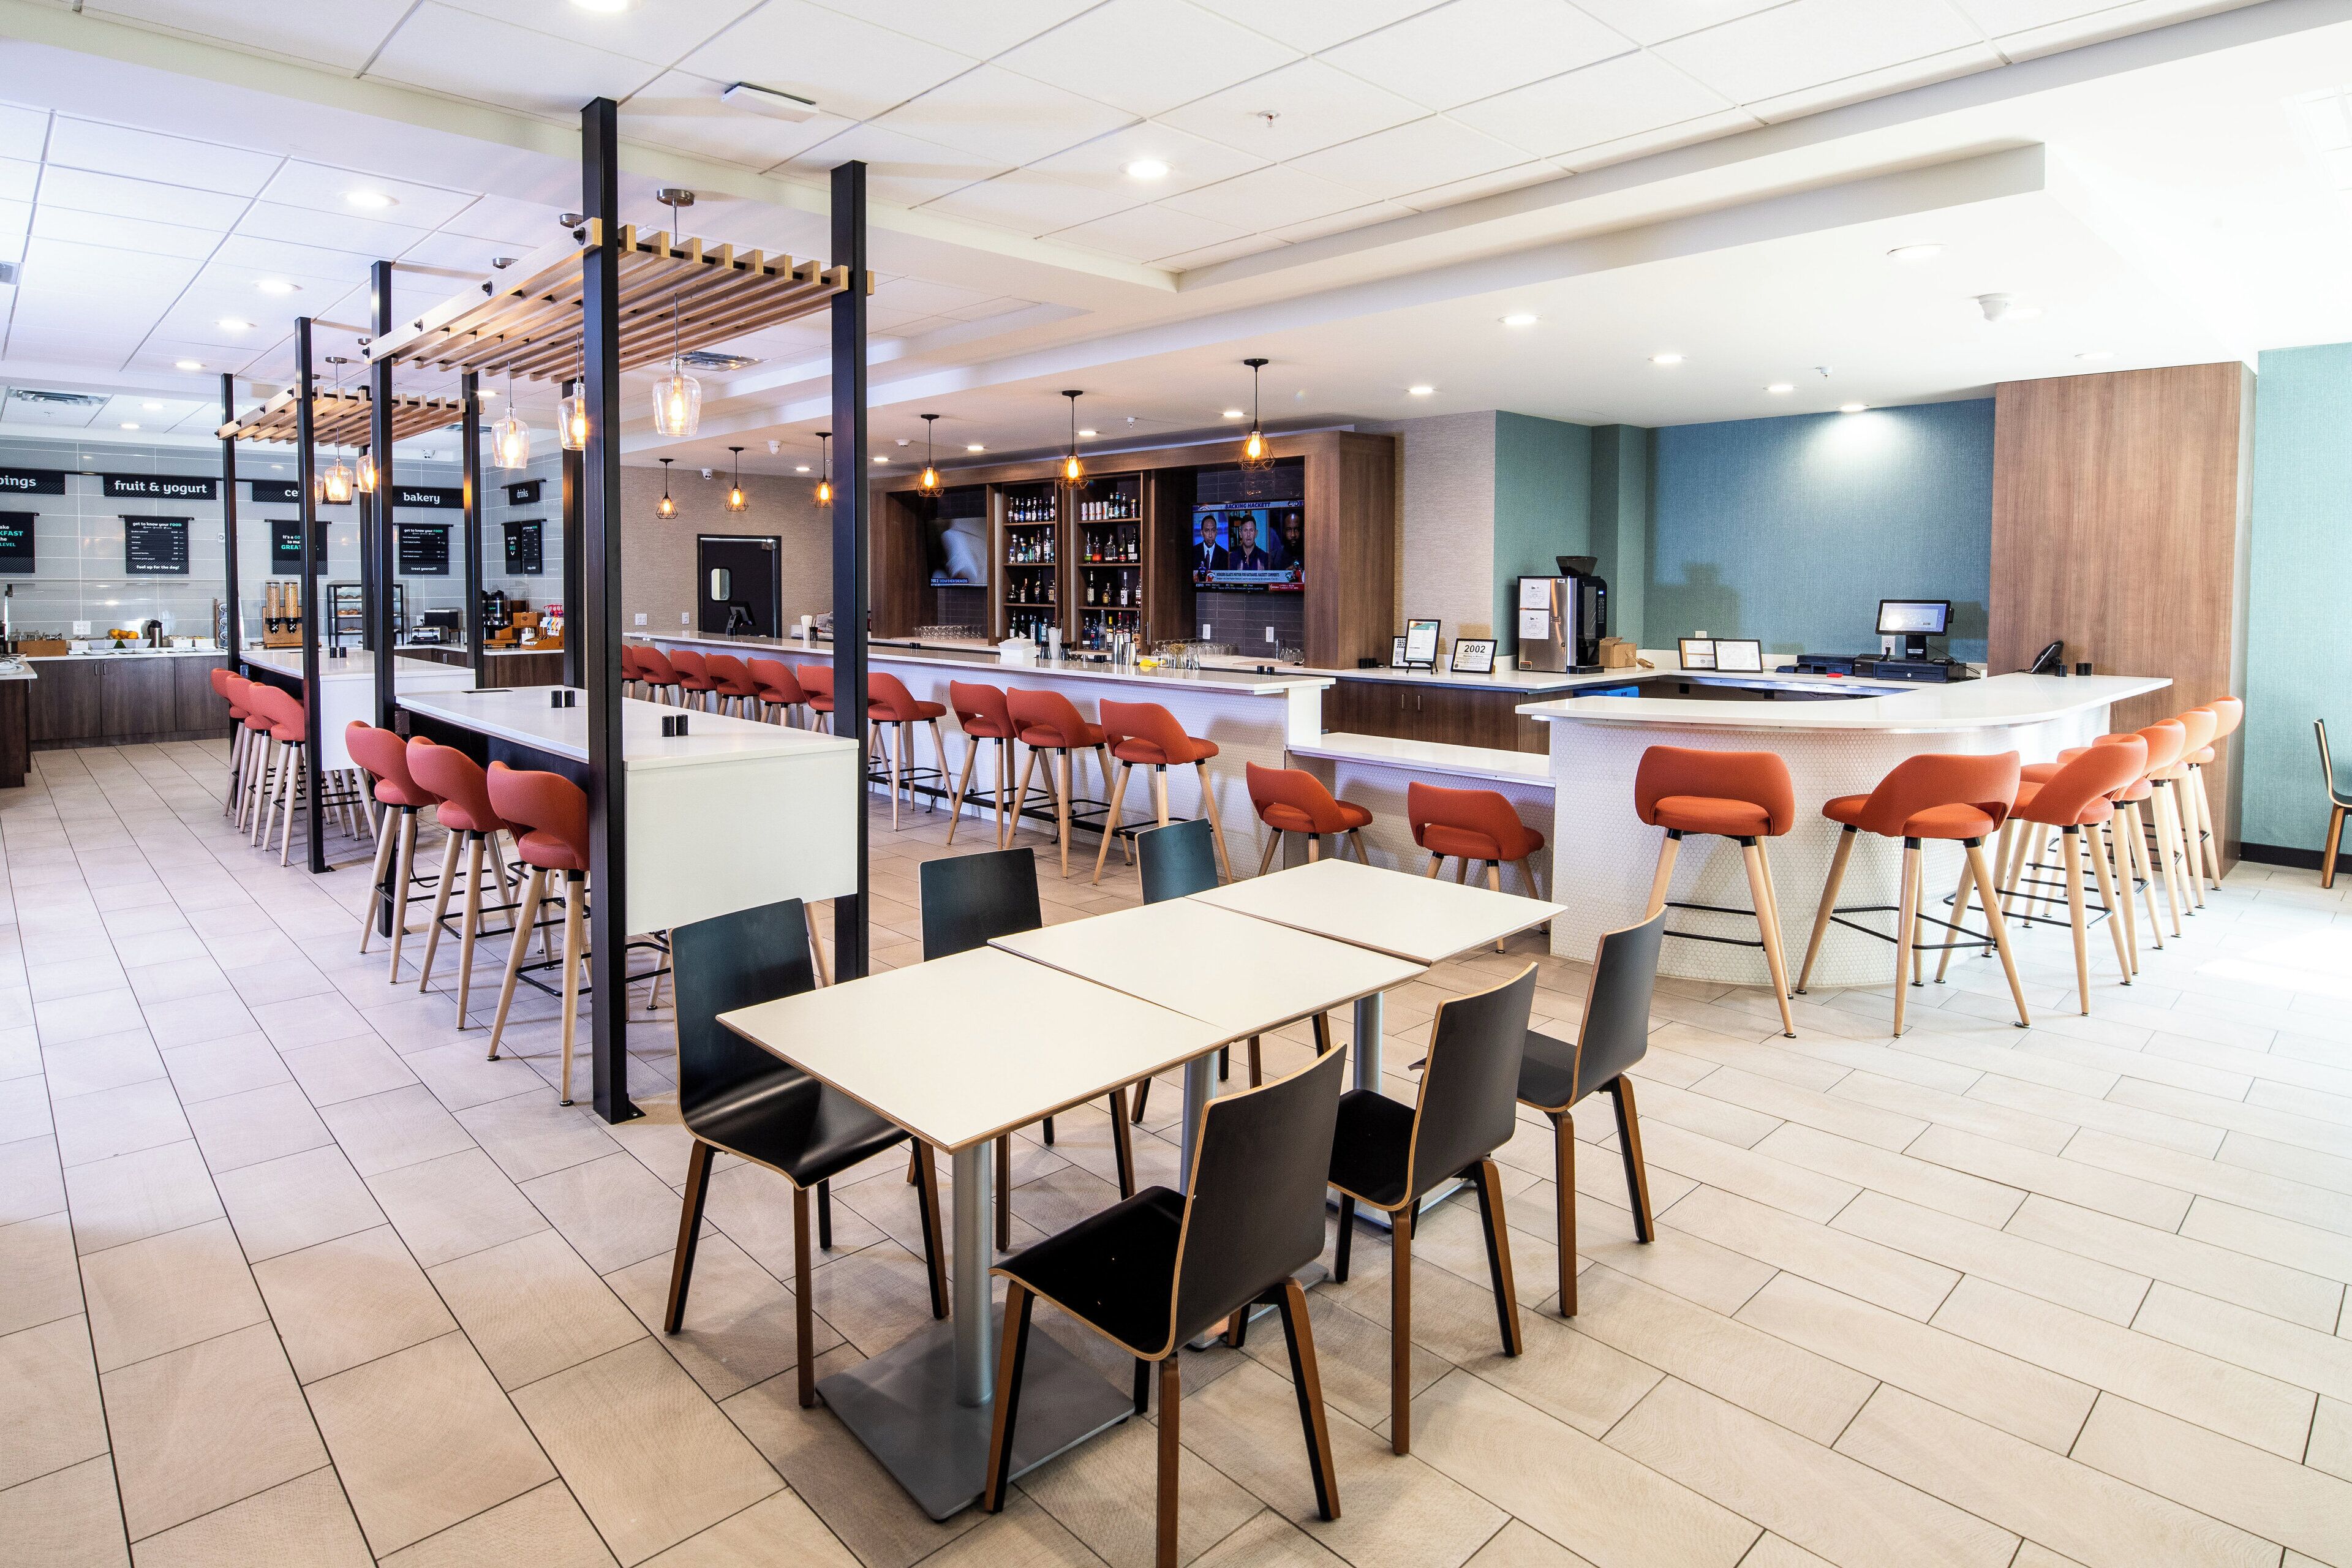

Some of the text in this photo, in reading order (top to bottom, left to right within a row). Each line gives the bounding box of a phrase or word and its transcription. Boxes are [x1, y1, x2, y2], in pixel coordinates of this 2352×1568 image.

[115, 480, 208, 495] fruit & yogurt
[403, 492, 440, 504] bakery
[516, 488, 529, 499] drinks
[1464, 644, 1485, 653] 2002
